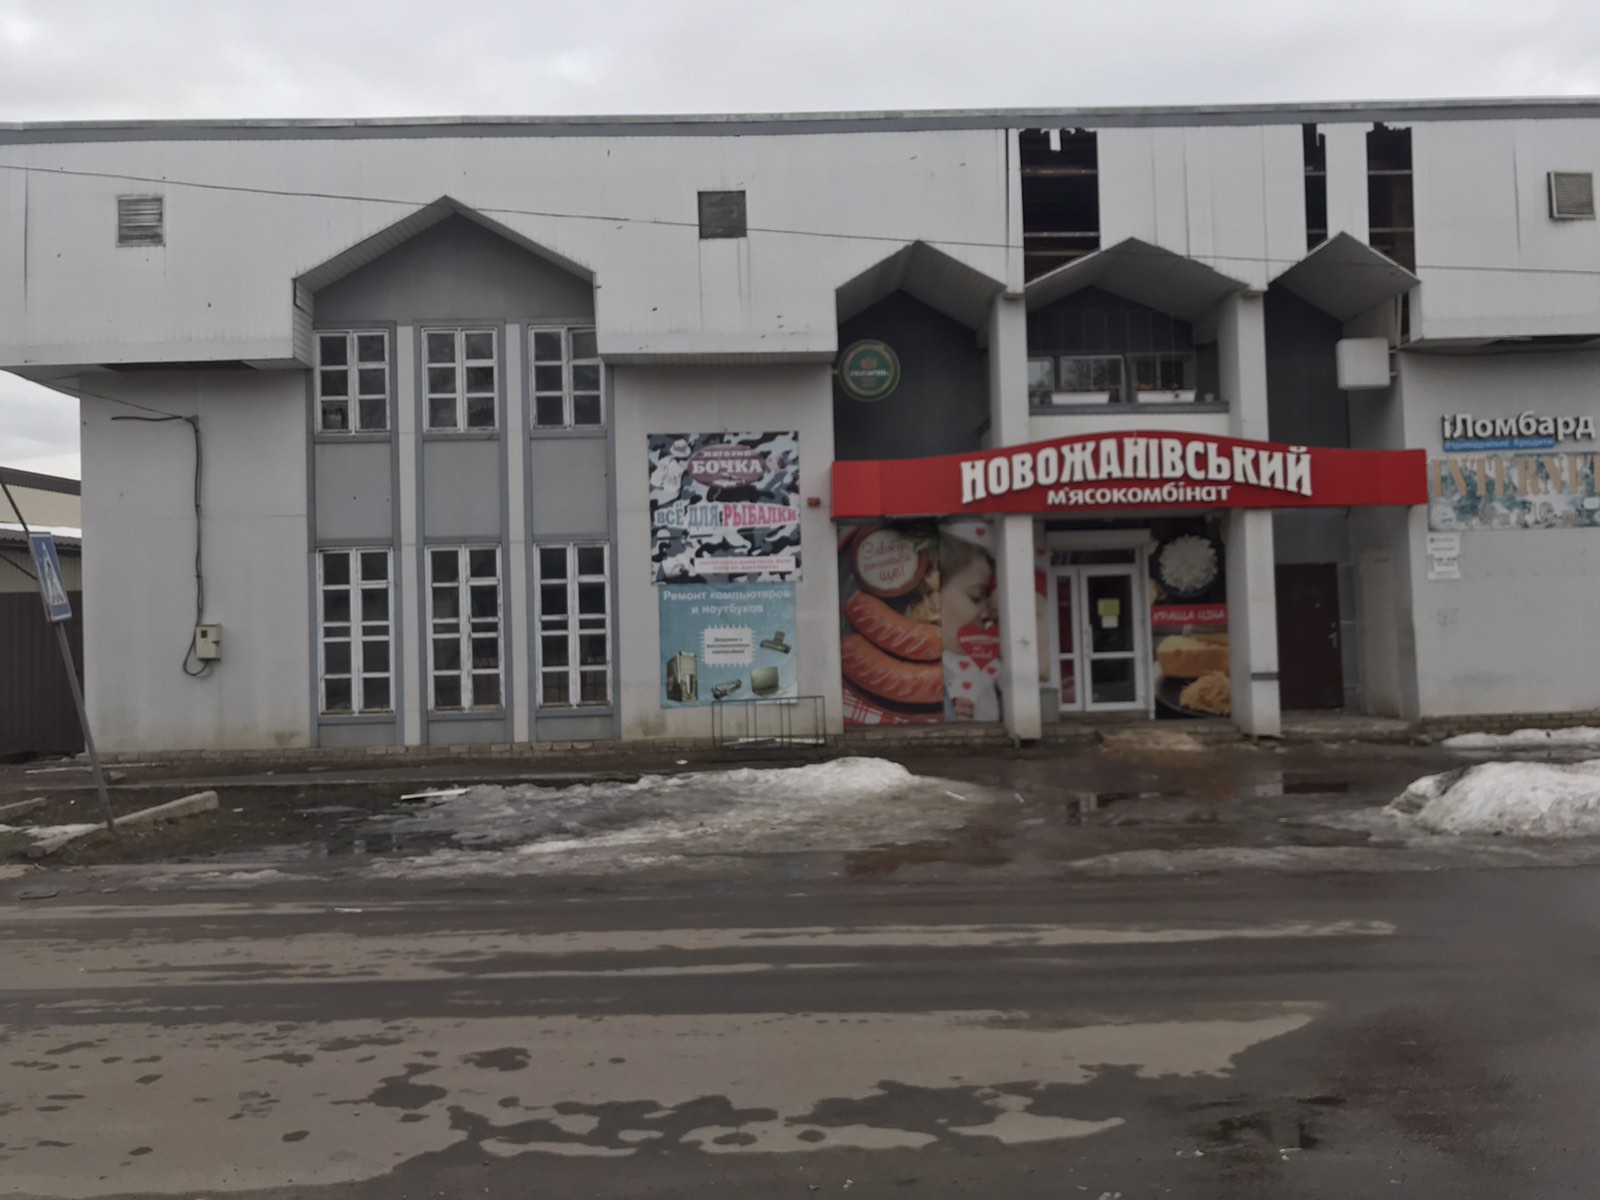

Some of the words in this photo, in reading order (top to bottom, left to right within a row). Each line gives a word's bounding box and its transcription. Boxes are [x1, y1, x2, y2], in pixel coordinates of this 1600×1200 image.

[1441, 410, 1598, 441] іЛомбард
[692, 459, 764, 474] БОЧКА
[960, 436, 1313, 504] НОВОЖАНІВСЬКИЙ
[688, 504, 719, 529] ДЛЯ
[722, 502, 798, 528] РЫБАЛКИ
[663, 590, 707, 601] Ремонт
[691, 606, 699, 614] и
[702, 603, 764, 616] ноутбуков
